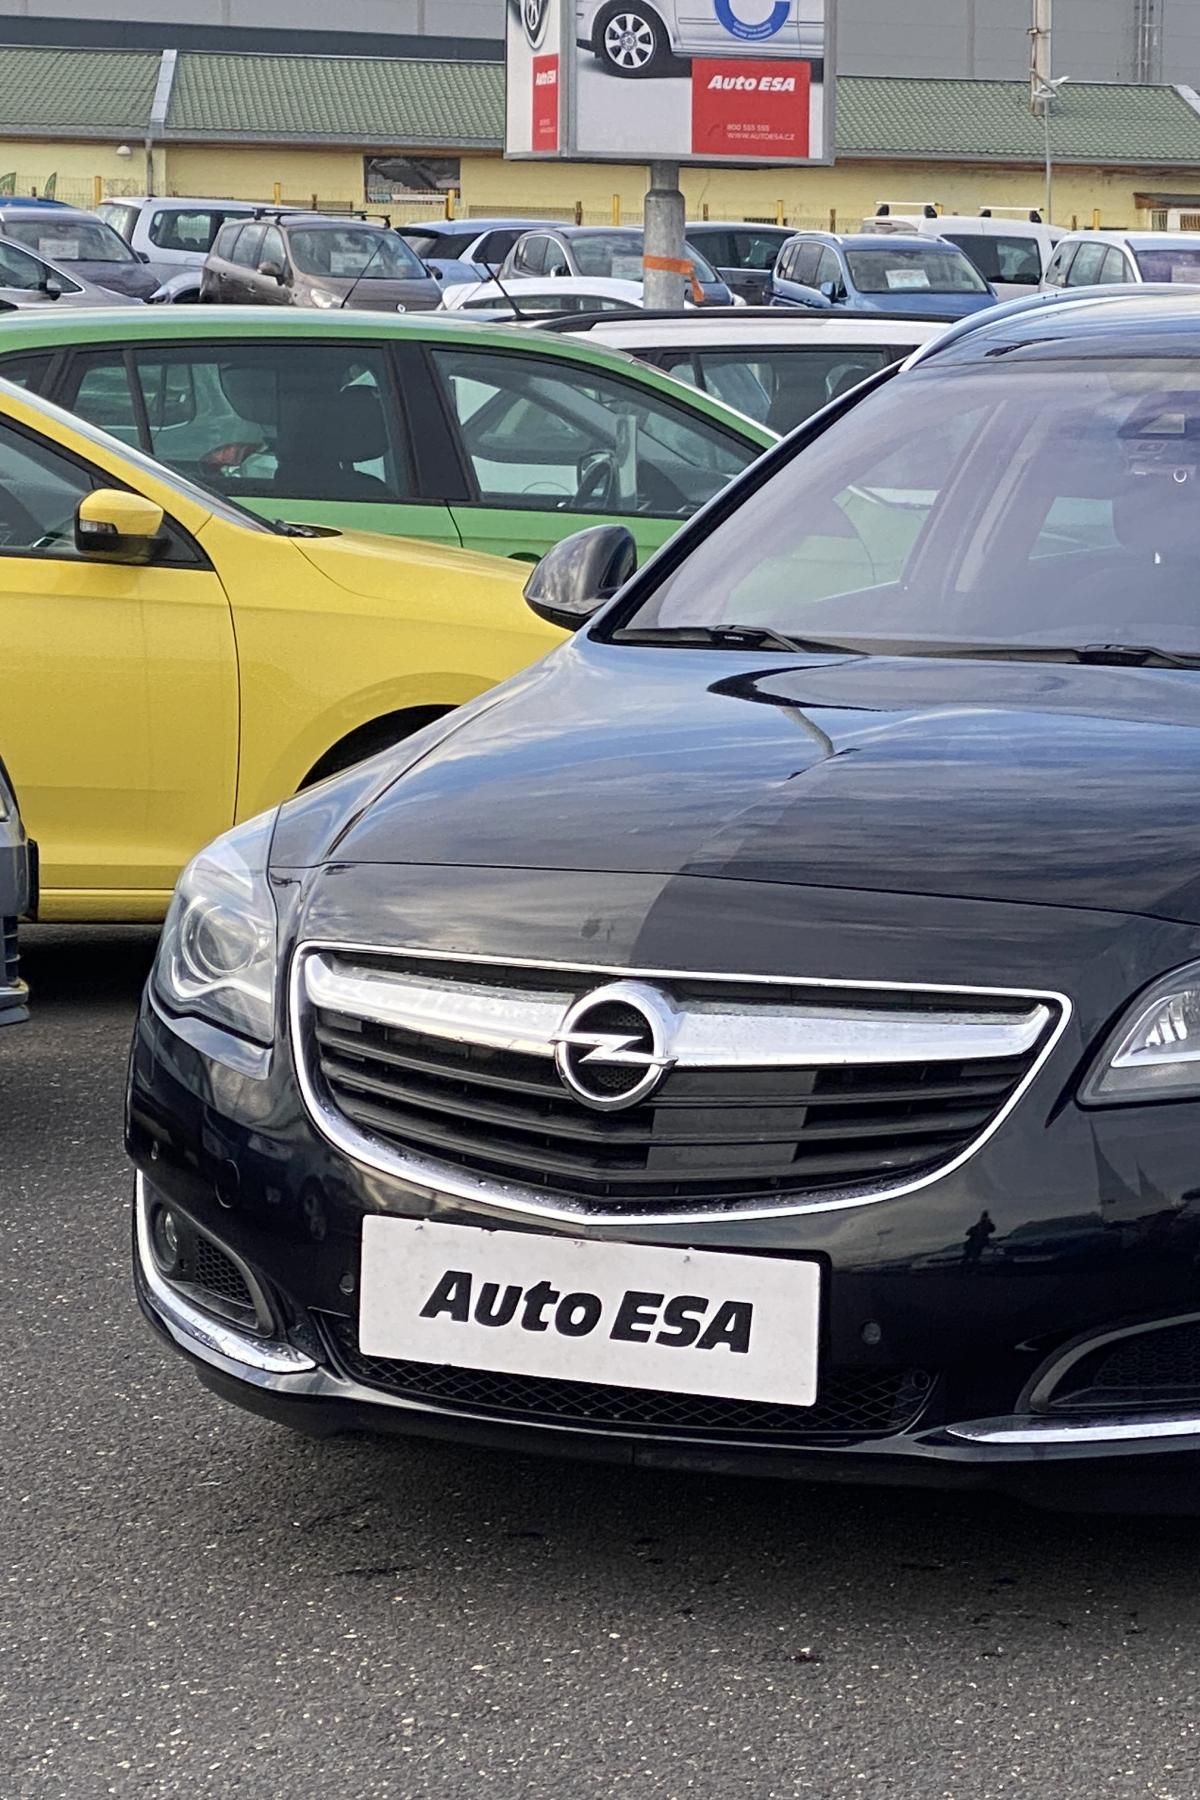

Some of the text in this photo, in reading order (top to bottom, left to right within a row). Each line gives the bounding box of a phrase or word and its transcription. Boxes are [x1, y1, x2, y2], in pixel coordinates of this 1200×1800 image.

[707, 75, 796, 92] Auto ESA
[419, 1270, 754, 1354] Auto ESA
